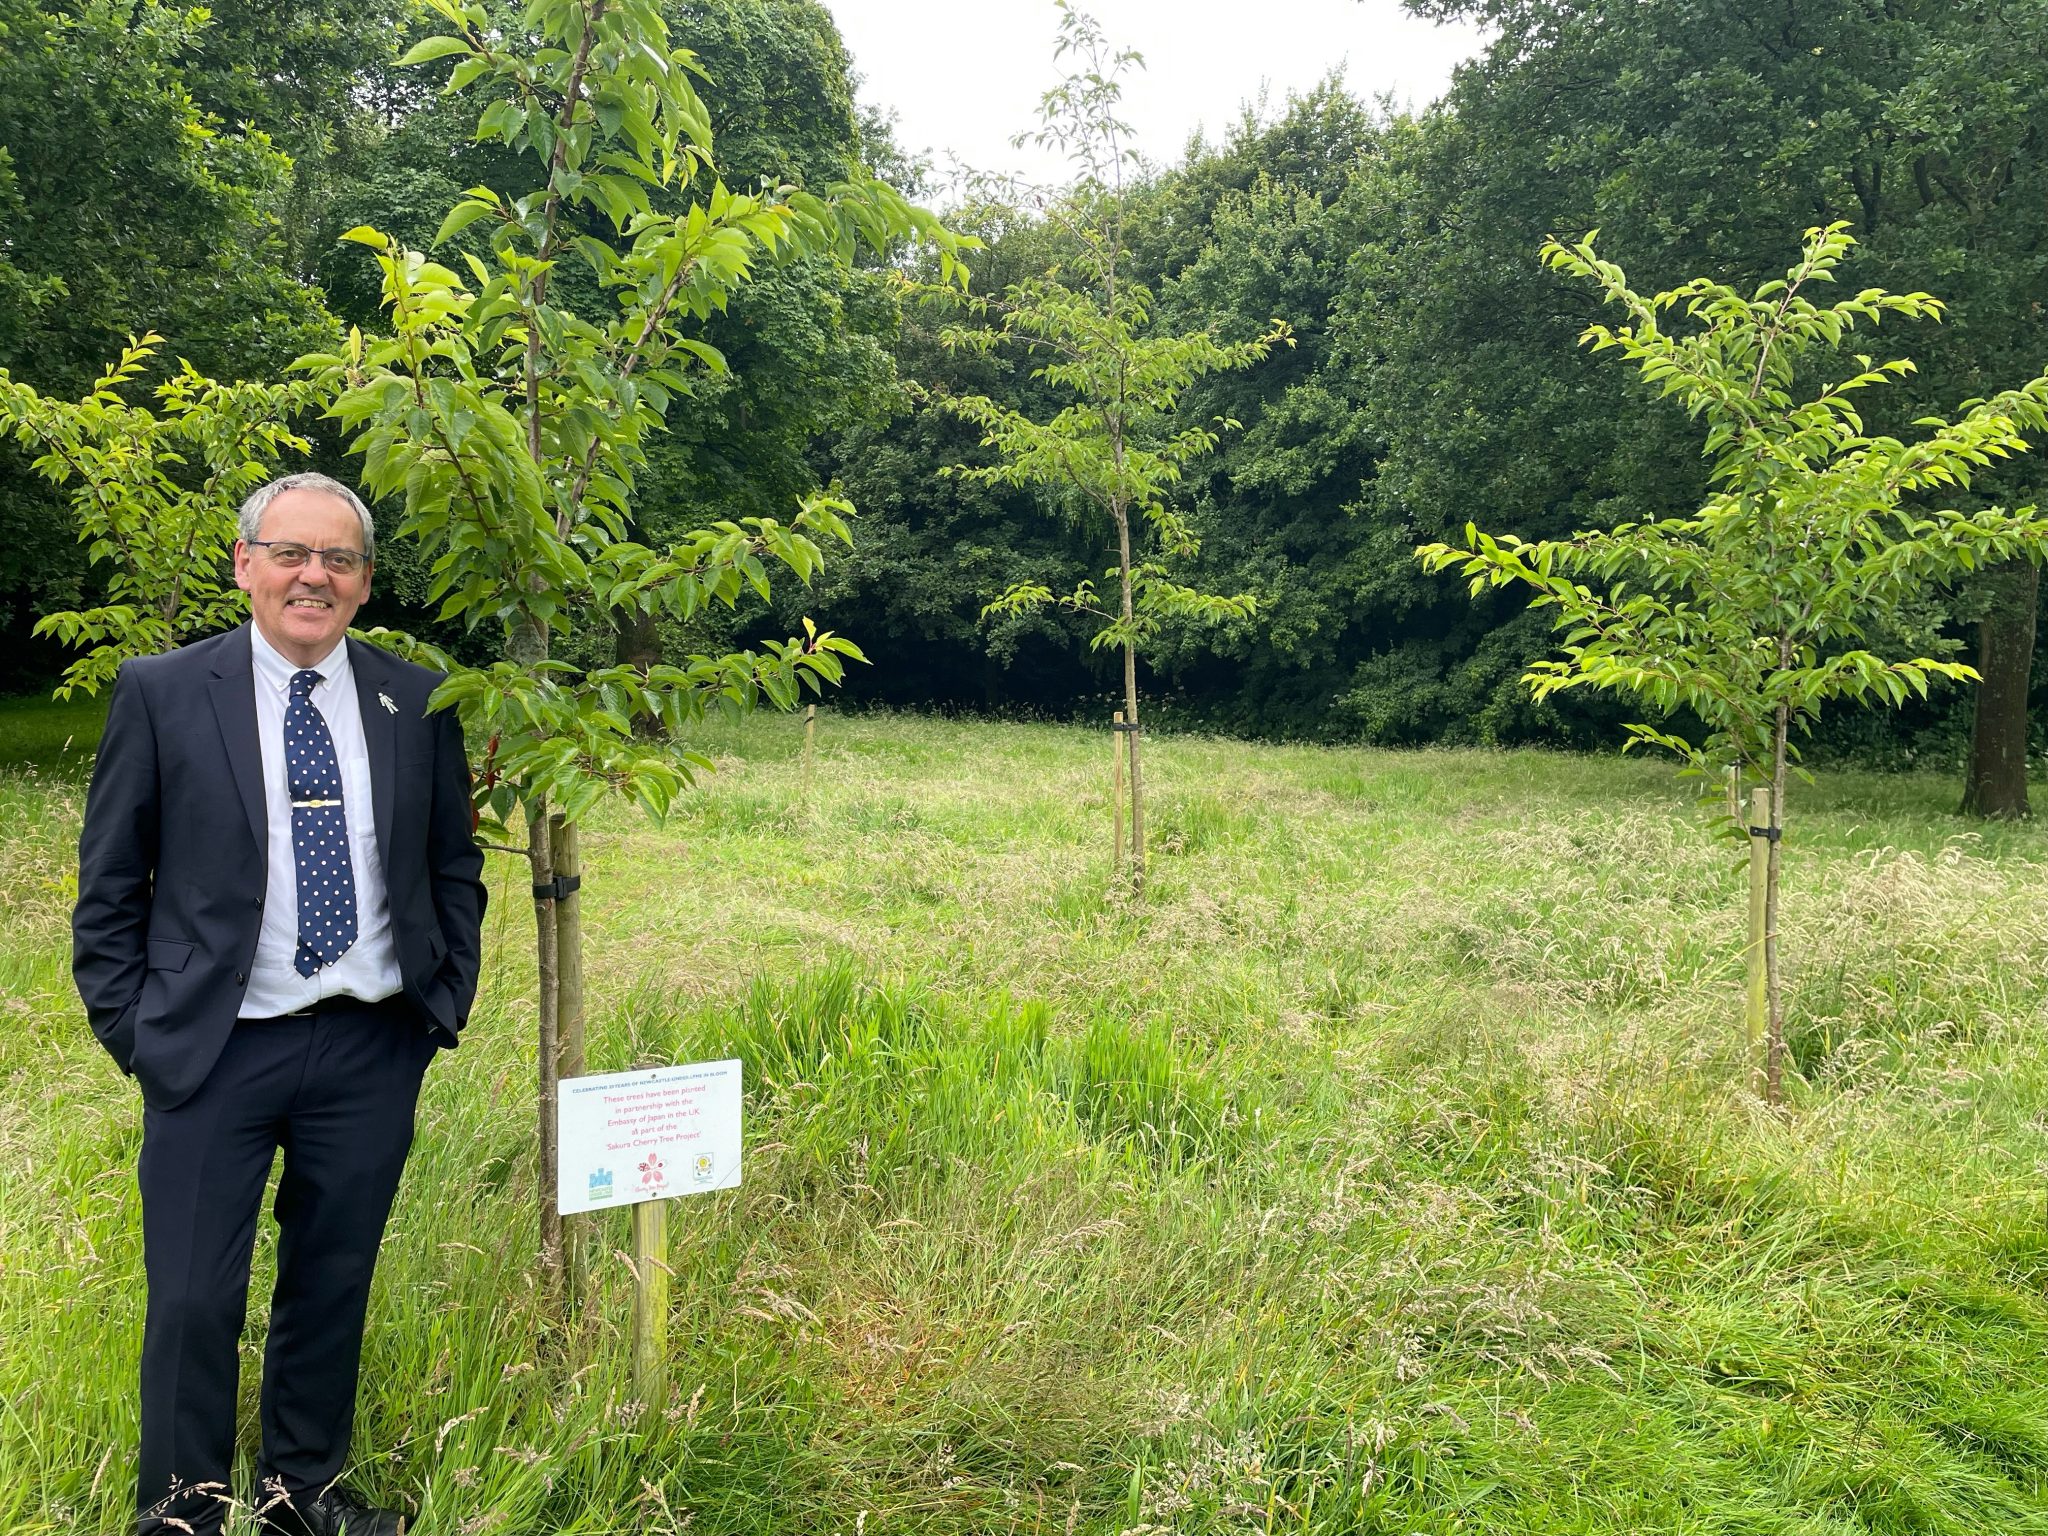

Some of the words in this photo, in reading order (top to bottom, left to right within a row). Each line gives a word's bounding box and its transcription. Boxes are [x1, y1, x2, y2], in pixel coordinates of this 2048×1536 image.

[604, 1096, 624, 1104] These
[646, 1091, 661, 1099] have
[681, 1085, 706, 1096] planted
[615, 1106, 622, 1114] in
[623, 1102, 663, 1115] partnership
[665, 1099, 680, 1108] with
[681, 1098, 693, 1106] the
[607, 1117, 637, 1127] Embassy
[638, 1115, 646, 1123] of
[647, 1113, 666, 1124] Japan
[688, 1108, 700, 1116] UK
[640, 1126, 655, 1136] part
[656, 1124, 665, 1132] of
[665, 1123, 677, 1131] the
[633, 1138, 658, 1148] Cherry
[659, 1135, 674, 1144] Tree
